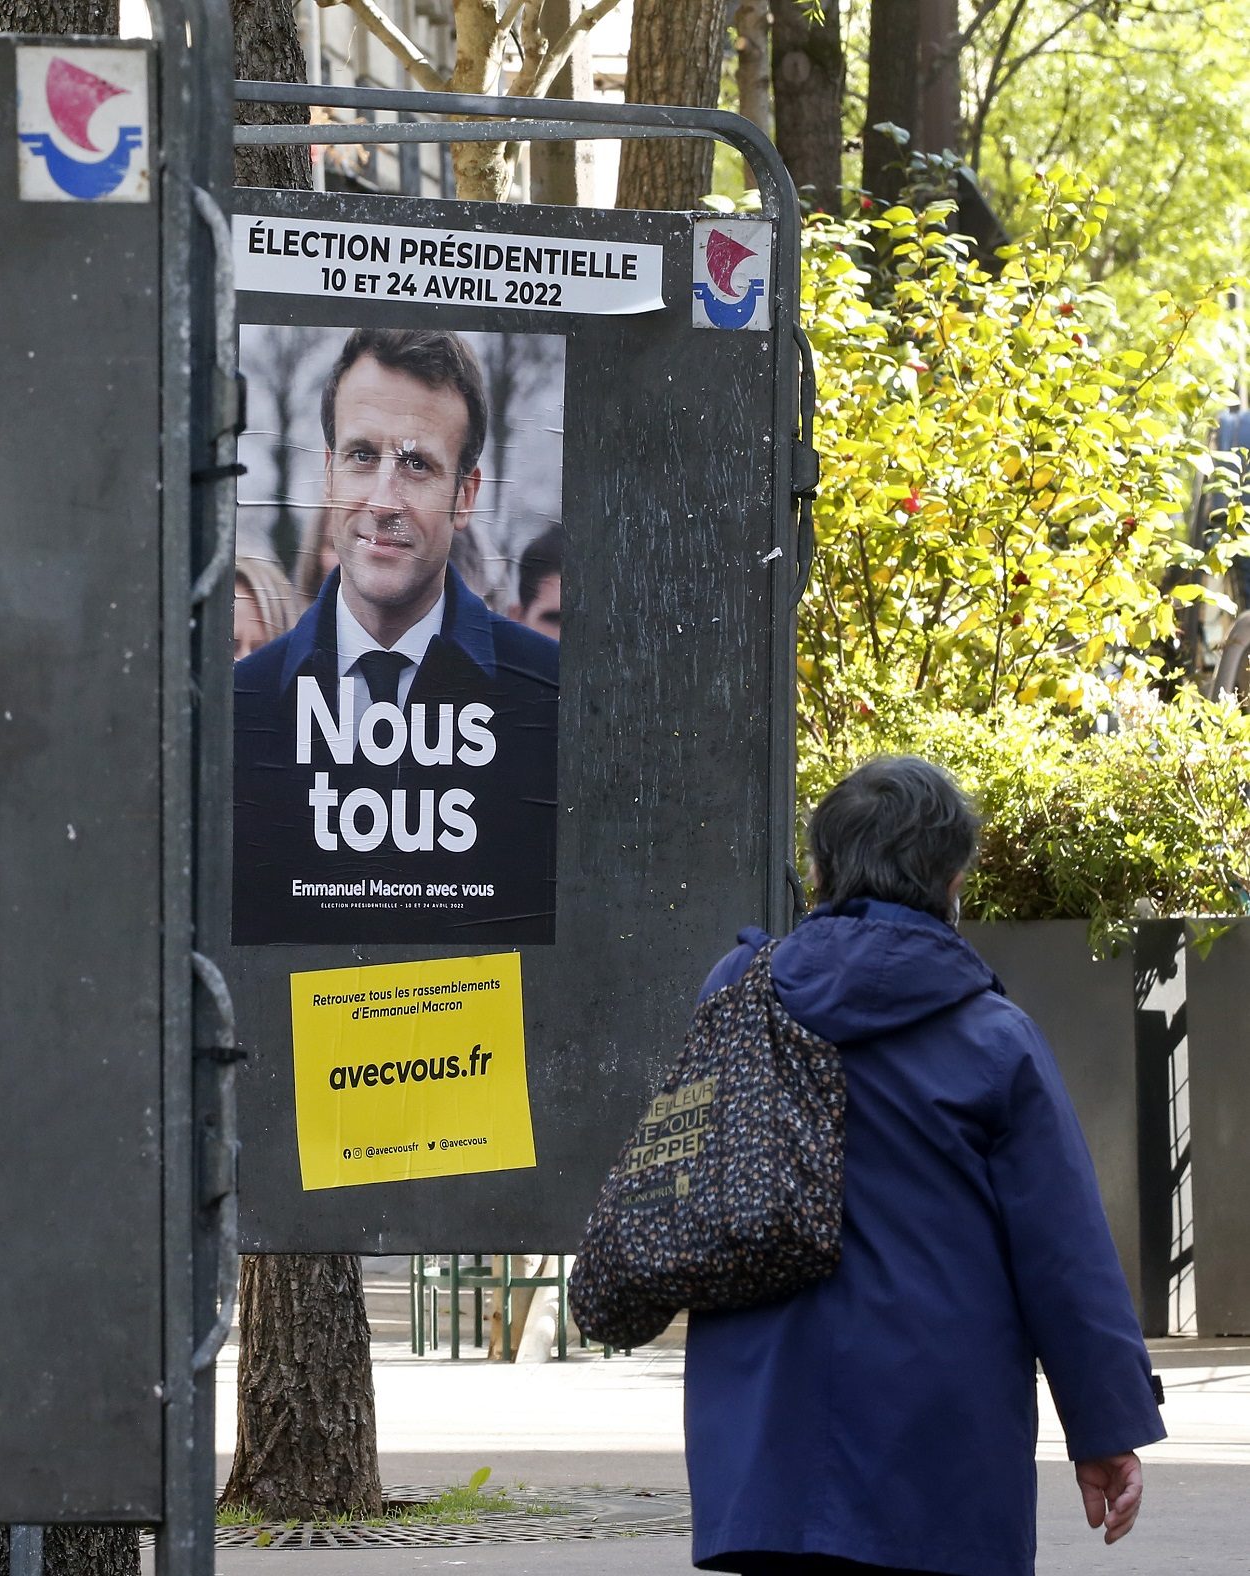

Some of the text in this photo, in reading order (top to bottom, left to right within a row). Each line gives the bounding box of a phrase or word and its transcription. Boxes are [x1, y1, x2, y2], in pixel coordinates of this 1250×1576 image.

[249, 220, 638, 280] ÉLECTION PRÉSIDENTIELLE
[322, 268, 562, 306] 10 ET 24 AVRIL 2022
[296, 676, 497, 766] Nous
[308, 771, 478, 853] tous
[292, 879, 495, 897] Emmanuel Macron avec vous
[313, 979, 500, 1007] Retrouvez tous les rassemblements
[351, 1000, 463, 1020] d'Emmanuel Macron
[329, 1044, 492, 1090] avecvous.fr
[365, 1136, 488, 1158] @avecvousfr @avecvous
